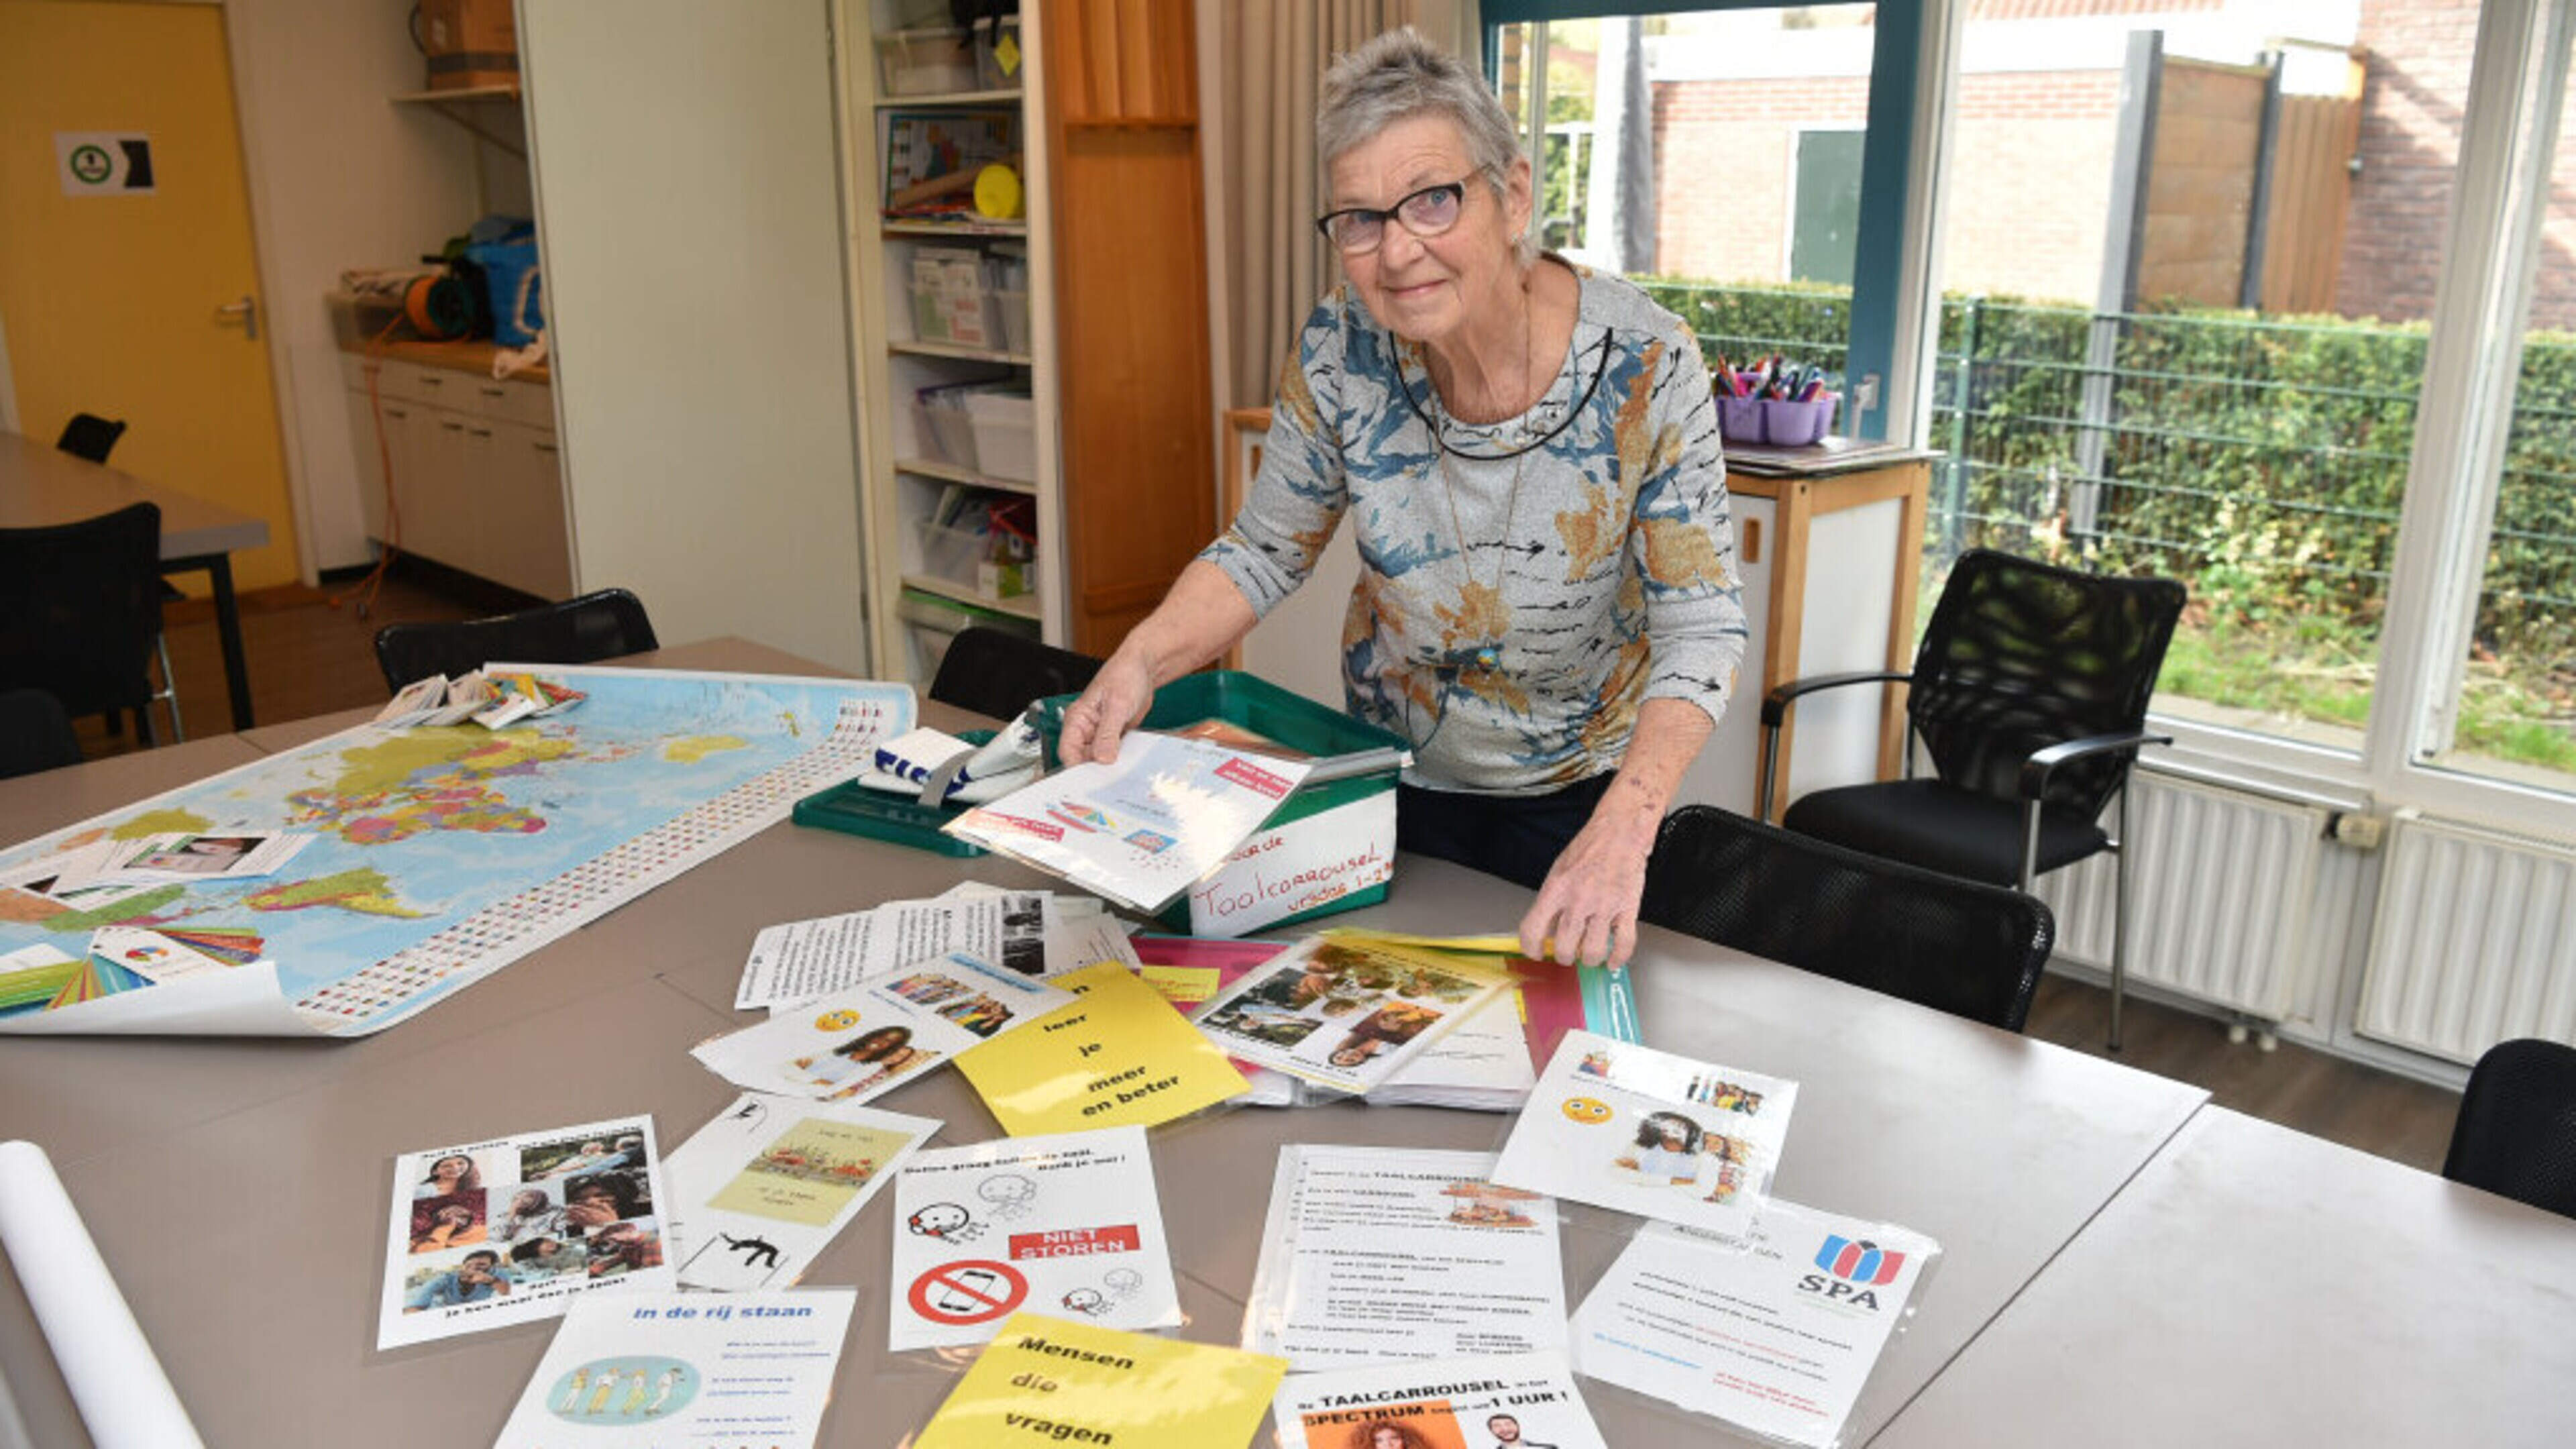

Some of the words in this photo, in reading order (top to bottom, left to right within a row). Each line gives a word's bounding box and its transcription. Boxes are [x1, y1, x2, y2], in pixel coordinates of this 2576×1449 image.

[1044, 1014, 1086, 1032] leer
[1079, 1043, 1102, 1057] je
[1088, 1066, 1145, 1092] meer
[1082, 1101, 1112, 1116] en
[1116, 1075, 1179, 1104] beter
[1019, 1240, 1125, 1258] STOREN
[1043, 1229, 1097, 1243] NIET
[1798, 1275, 1880, 1311] SPA
[665, 1305, 697, 1319] de
[705, 1305, 733, 1321] rij
[740, 1305, 813, 1318] staan
[1018, 1336, 1134, 1369] Mensen
[1011, 1373, 1059, 1392] die
[1320, 1380, 1510, 1407] TAALCARROUSEL
[1304, 1405, 1425, 1426] SPECTRUM
[1508, 1392, 1555, 1406] UUR
[1006, 1413, 1114, 1446] vragen
